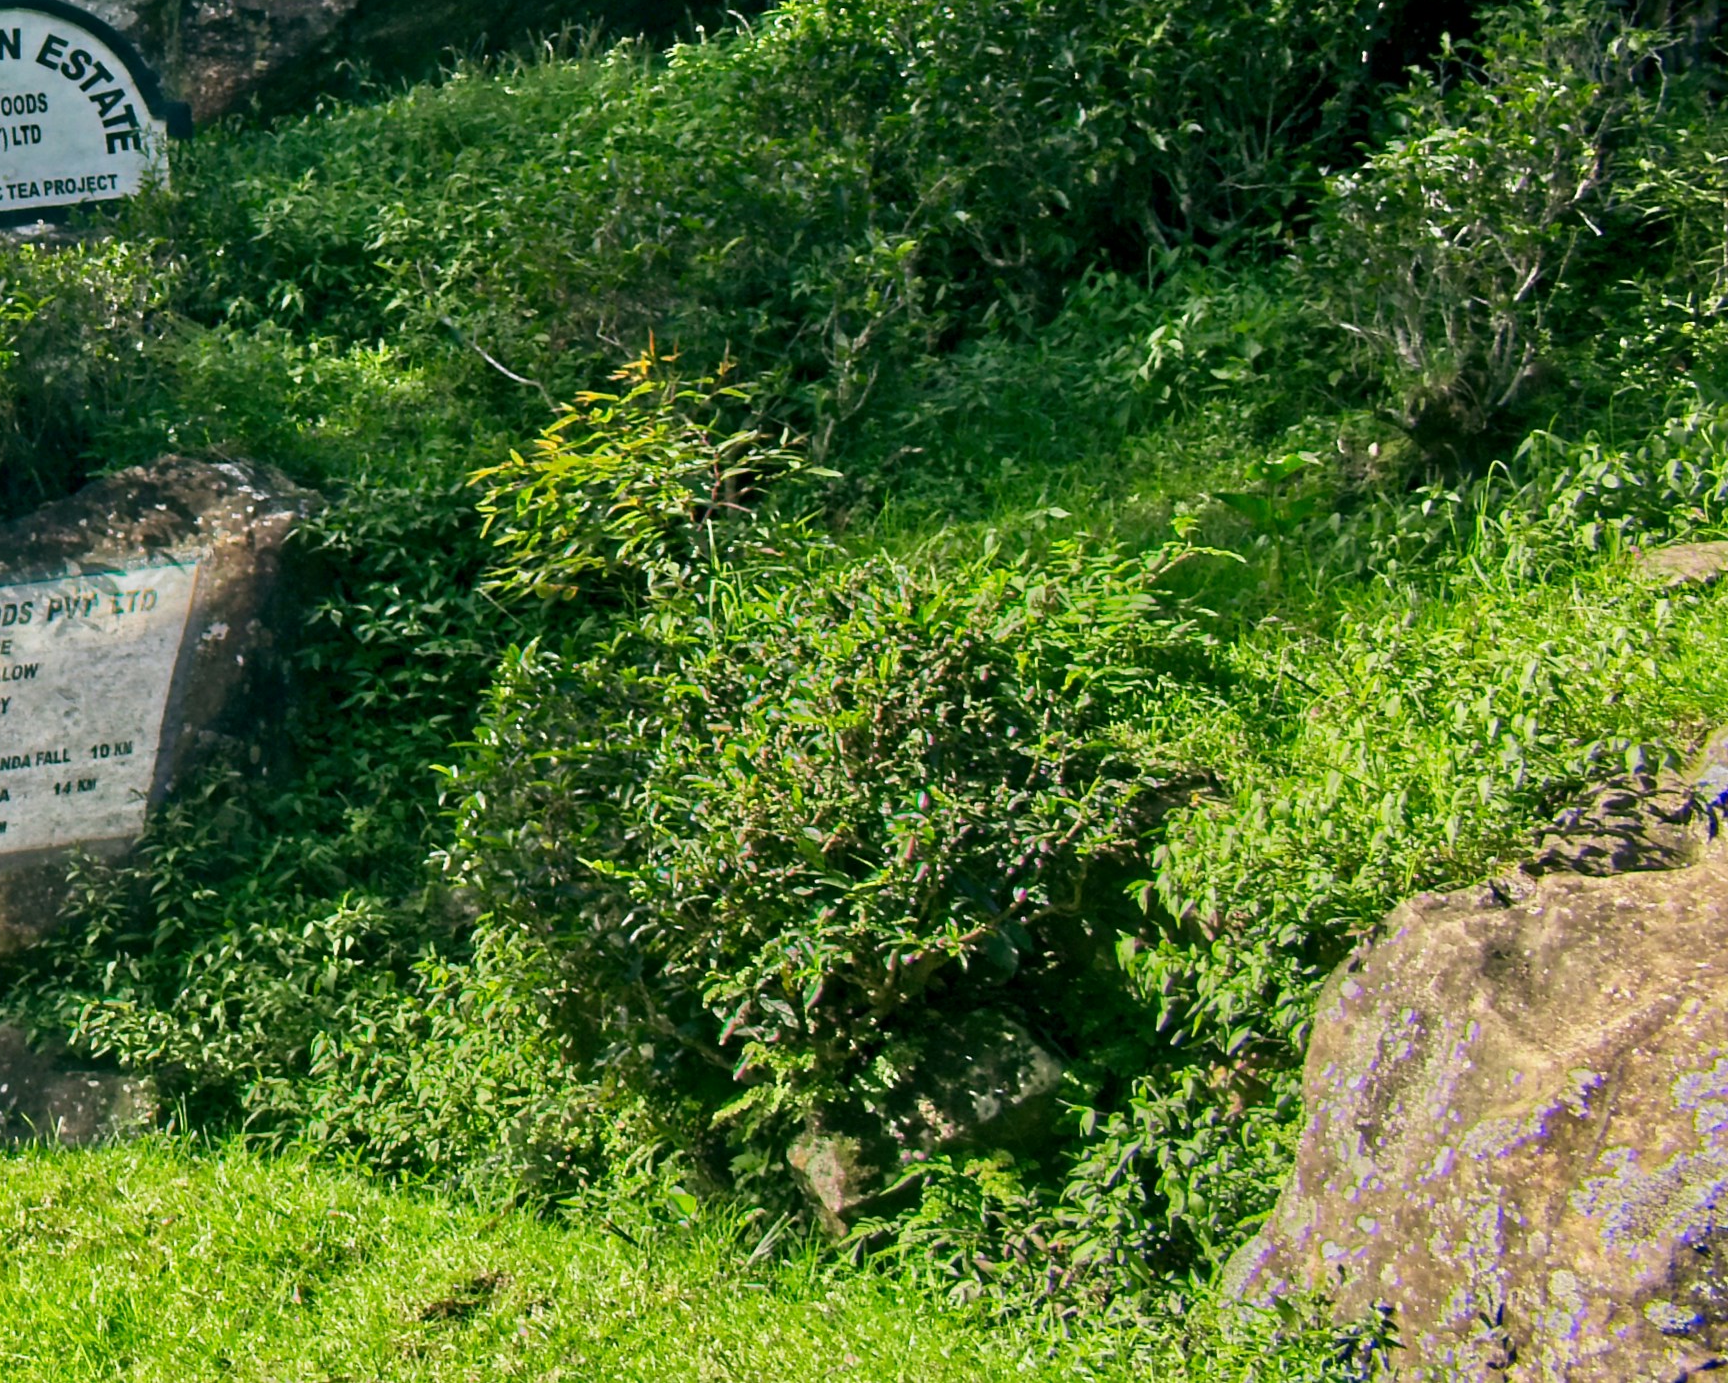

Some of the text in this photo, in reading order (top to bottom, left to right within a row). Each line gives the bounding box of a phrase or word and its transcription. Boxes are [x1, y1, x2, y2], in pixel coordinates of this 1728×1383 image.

[35, 33, 142, 155] ESTATE
[12, 124, 42, 146] LTD
[6, 180, 40, 200] TEA
[44, 174, 118, 197] PROJECT
[46, 592, 97, 622] PVT
[111, 588, 158, 615] LTD
[35, 748, 72, 767] FALL
[90, 743, 110, 760] 10
[113, 740, 133, 757] KM
[53, 781, 72, 796] 14
[77, 778, 97, 793] KM
